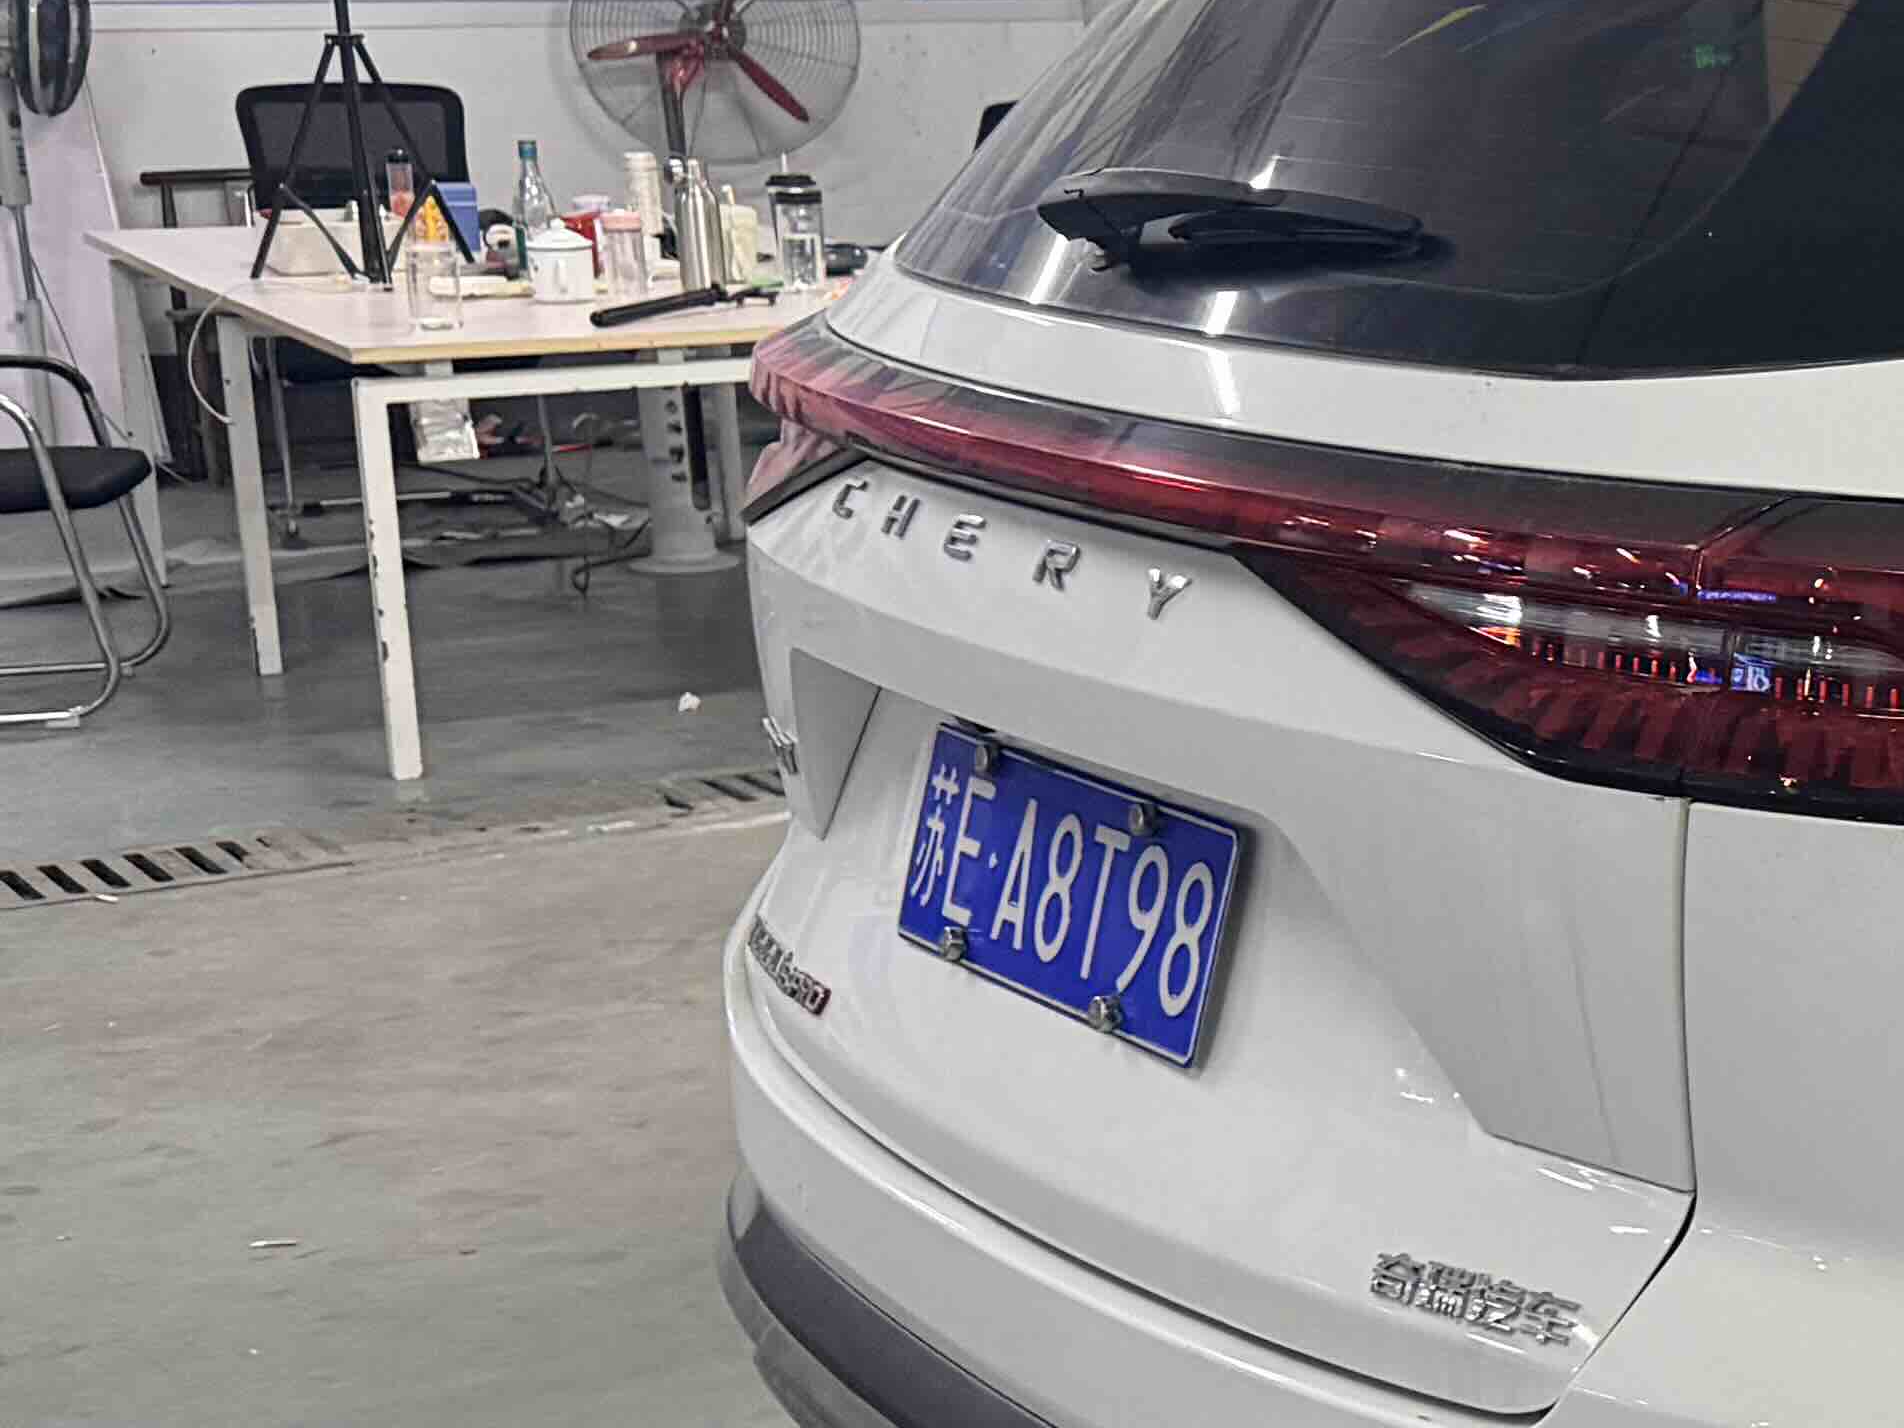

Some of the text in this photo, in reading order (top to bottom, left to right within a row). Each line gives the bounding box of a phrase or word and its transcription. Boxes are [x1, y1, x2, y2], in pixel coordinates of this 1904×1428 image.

[832, 479, 1193, 621] CHERY
[1370, 1252, 1582, 1346] 奇瑞汽车
